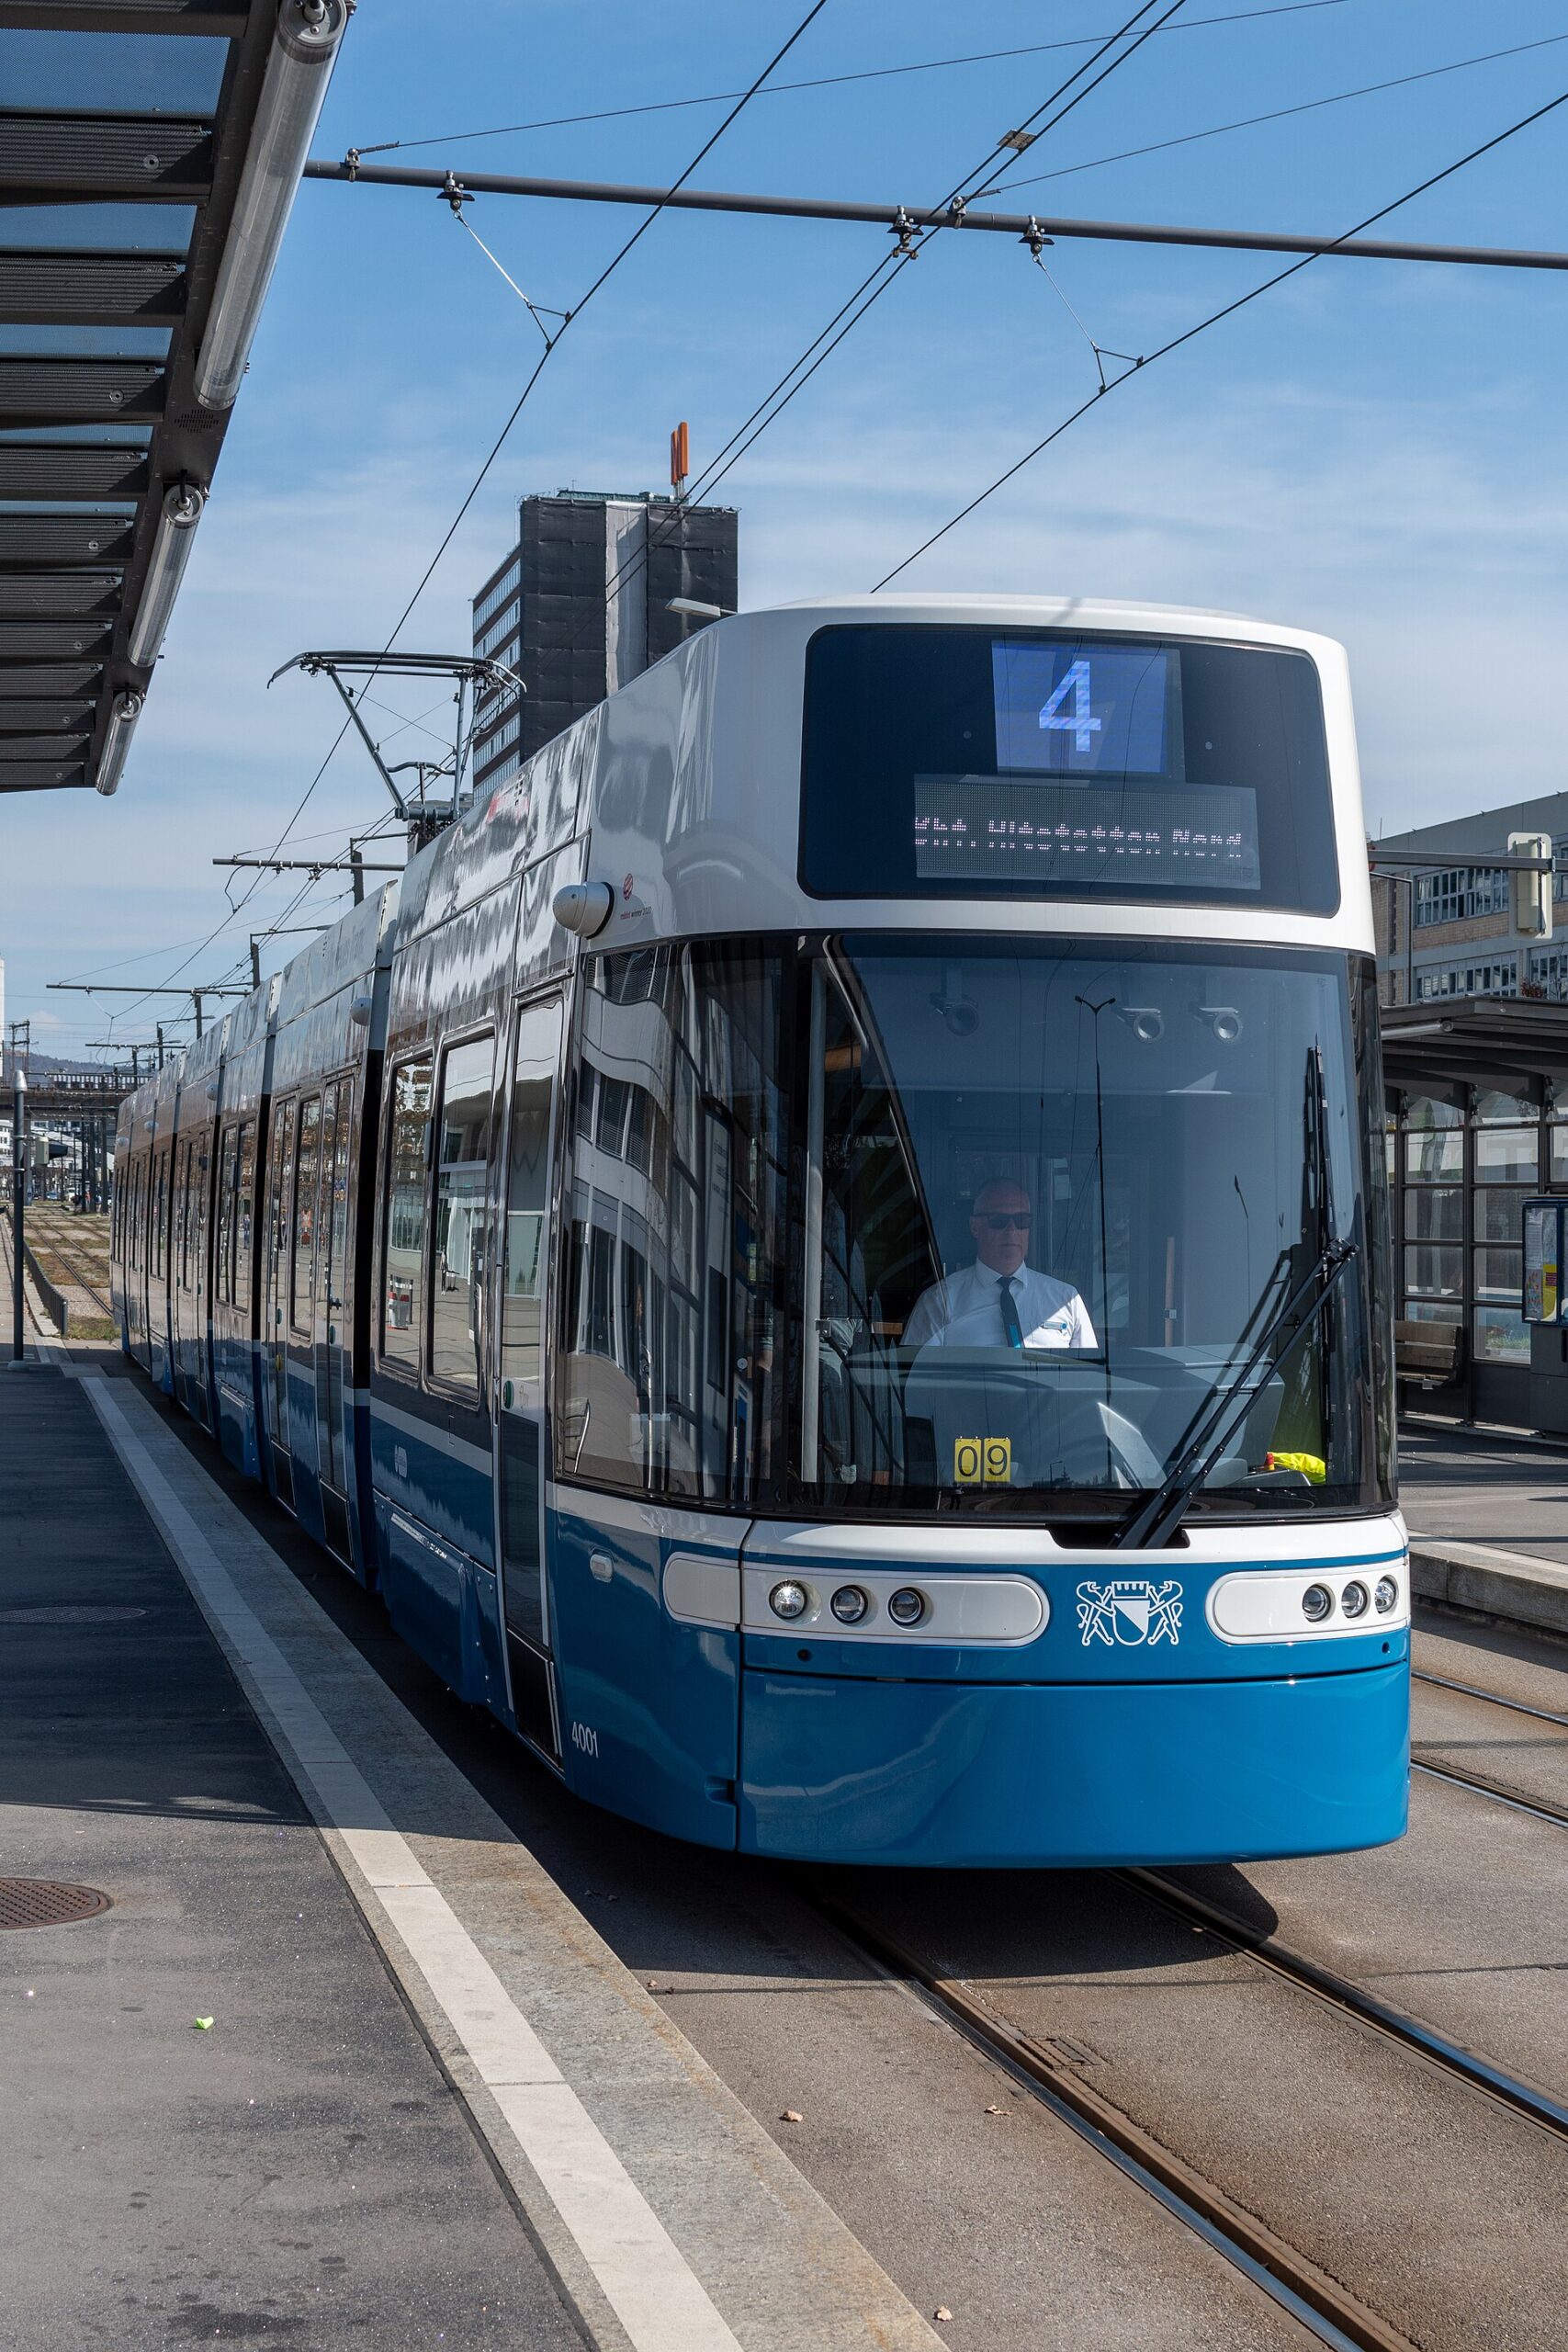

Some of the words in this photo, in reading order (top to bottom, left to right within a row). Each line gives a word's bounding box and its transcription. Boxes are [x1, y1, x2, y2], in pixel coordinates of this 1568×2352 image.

[1038, 660, 1102, 753] 4
[957, 1444, 1008, 1477] 09
[571, 1721, 599, 1758] 4001
